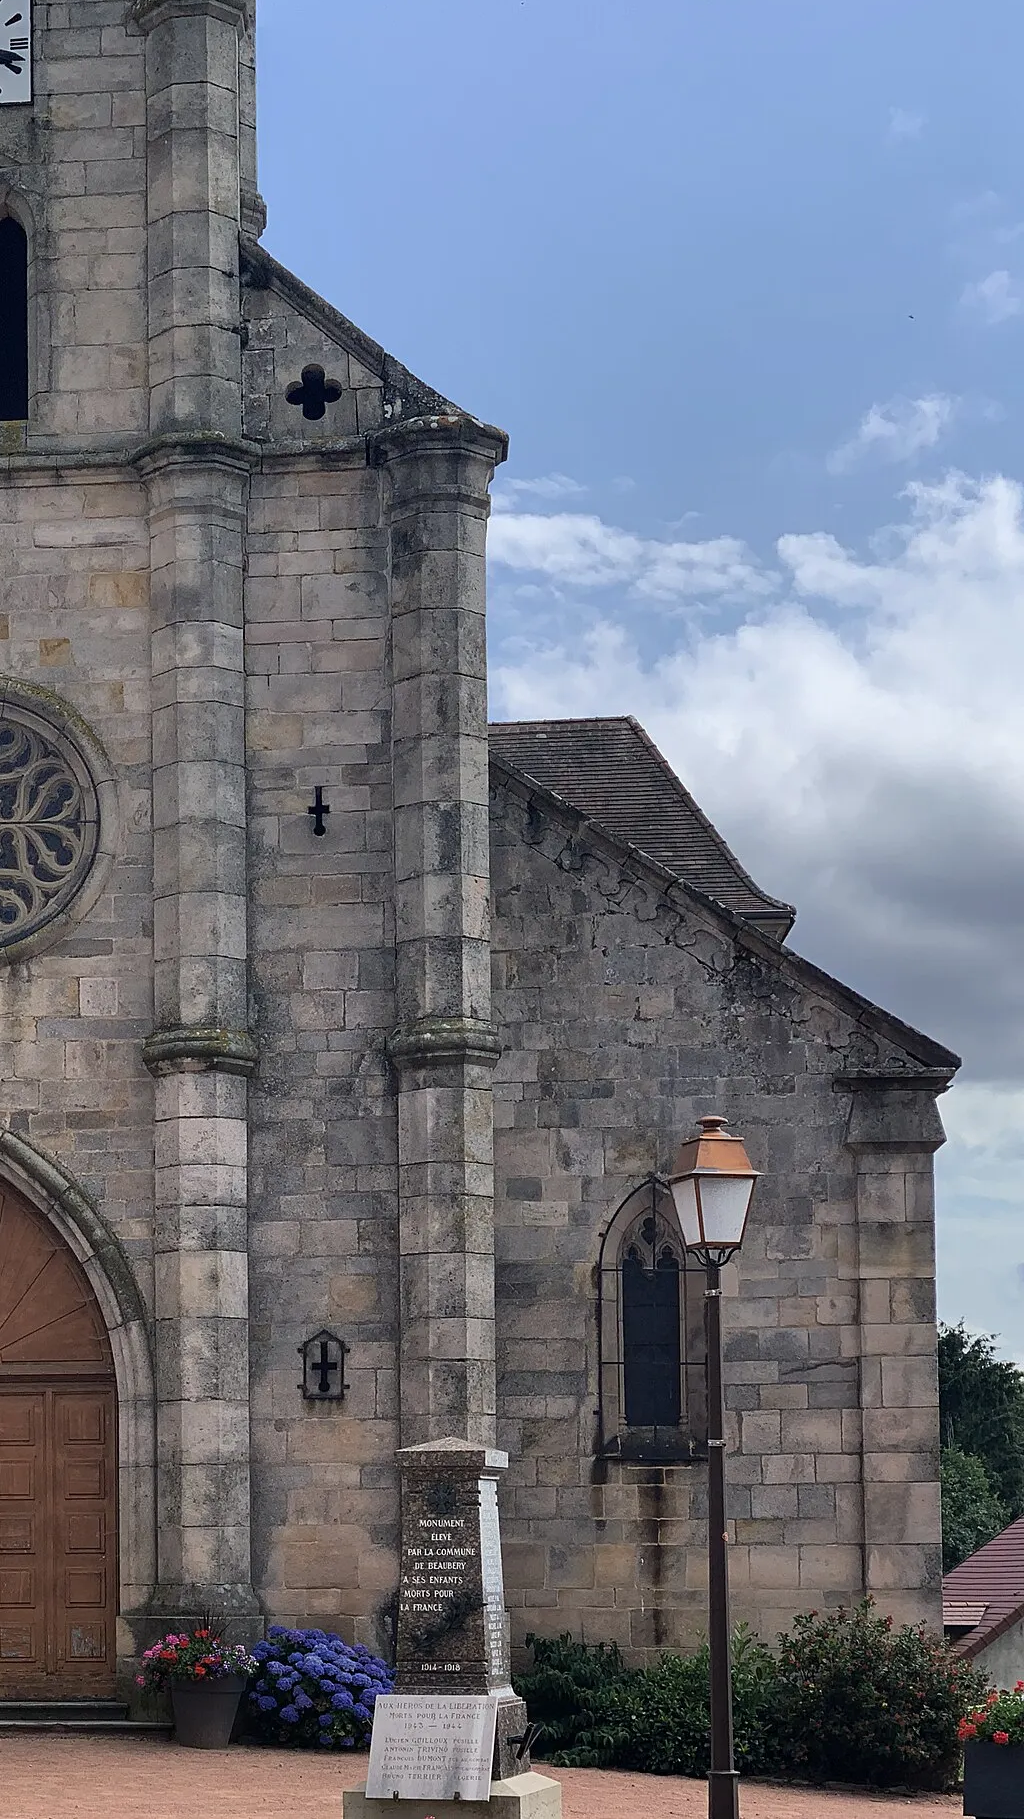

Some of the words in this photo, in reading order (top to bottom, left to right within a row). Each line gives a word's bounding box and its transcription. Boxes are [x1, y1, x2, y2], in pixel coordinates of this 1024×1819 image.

[418, 1519, 465, 1528] MONUMENT
[407, 1548, 422, 1556] PAR
[424, 1548, 434, 1556] LA
[436, 1548, 476, 1556] COMMUNE
[414, 1562, 425, 1570] DE
[428, 1562, 466, 1570] BEAUBERY
[411, 1575, 426, 1583] SES
[429, 1576, 464, 1584] ENFANTS
[403, 1589, 431, 1598] MORTS
[434, 1589, 454, 1598] POUR
[400, 1603, 410, 1611] LA
[413, 1603, 443, 1612] FRANCE
[425, 1702, 434, 1710] DE
[437, 1702, 447, 1710] LA
